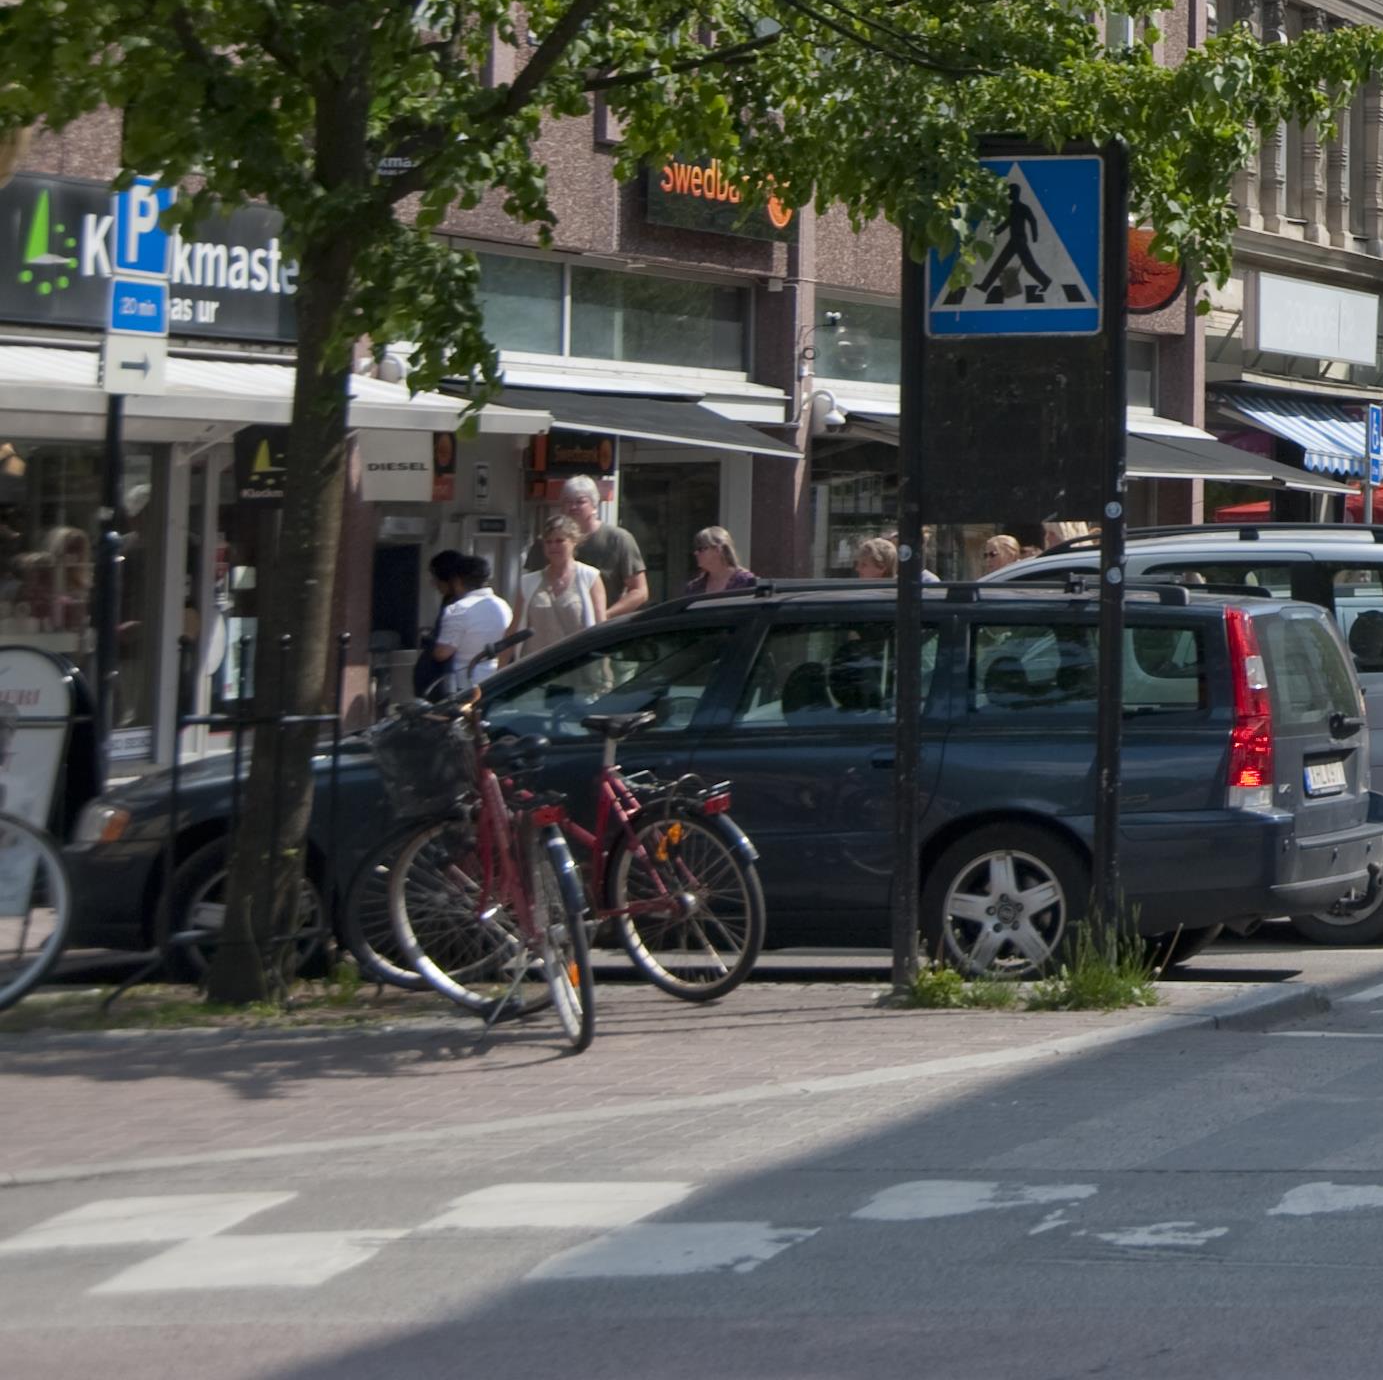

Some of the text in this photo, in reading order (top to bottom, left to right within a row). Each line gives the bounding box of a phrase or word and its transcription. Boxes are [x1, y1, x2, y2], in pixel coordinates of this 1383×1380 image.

[125, 185, 160, 263] P
[119, 296, 157, 317] 20 min
[197, 301, 220, 323] ur
[367, 462, 429, 472] DIESEL
